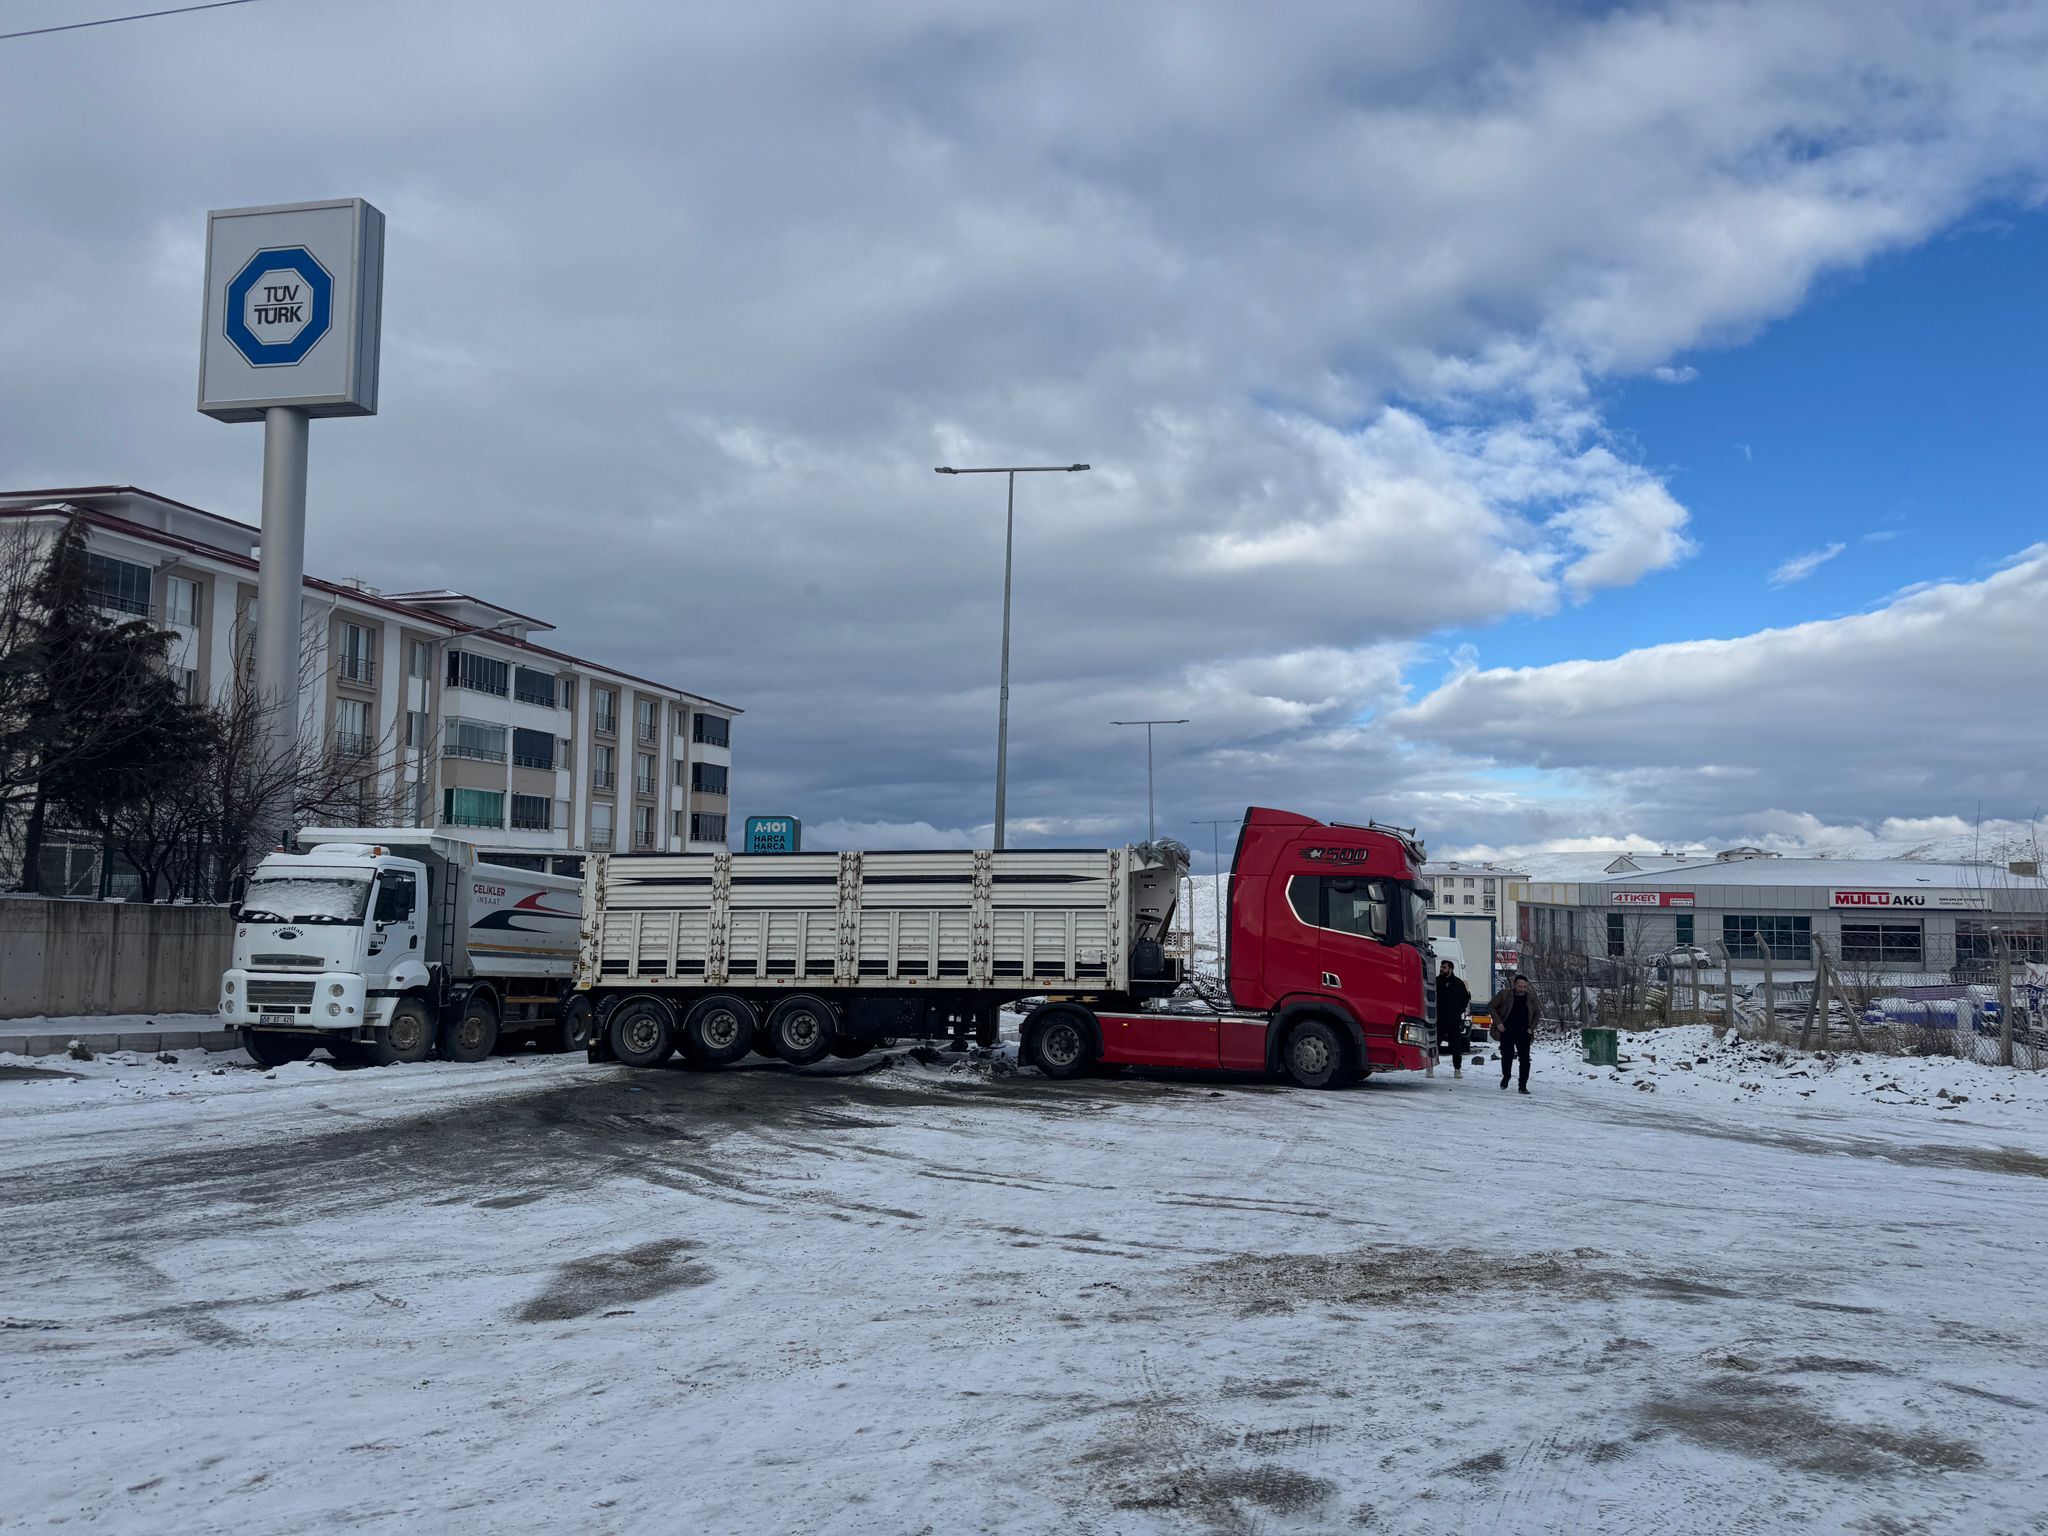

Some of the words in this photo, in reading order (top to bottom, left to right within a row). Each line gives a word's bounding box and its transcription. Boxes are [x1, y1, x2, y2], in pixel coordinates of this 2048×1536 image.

[264, 285, 299, 302] TÜV
[254, 306, 302, 324] TÜRK
[1835, 892, 1889, 904] MUTLU
[1893, 896, 1925, 905] AKÜ
